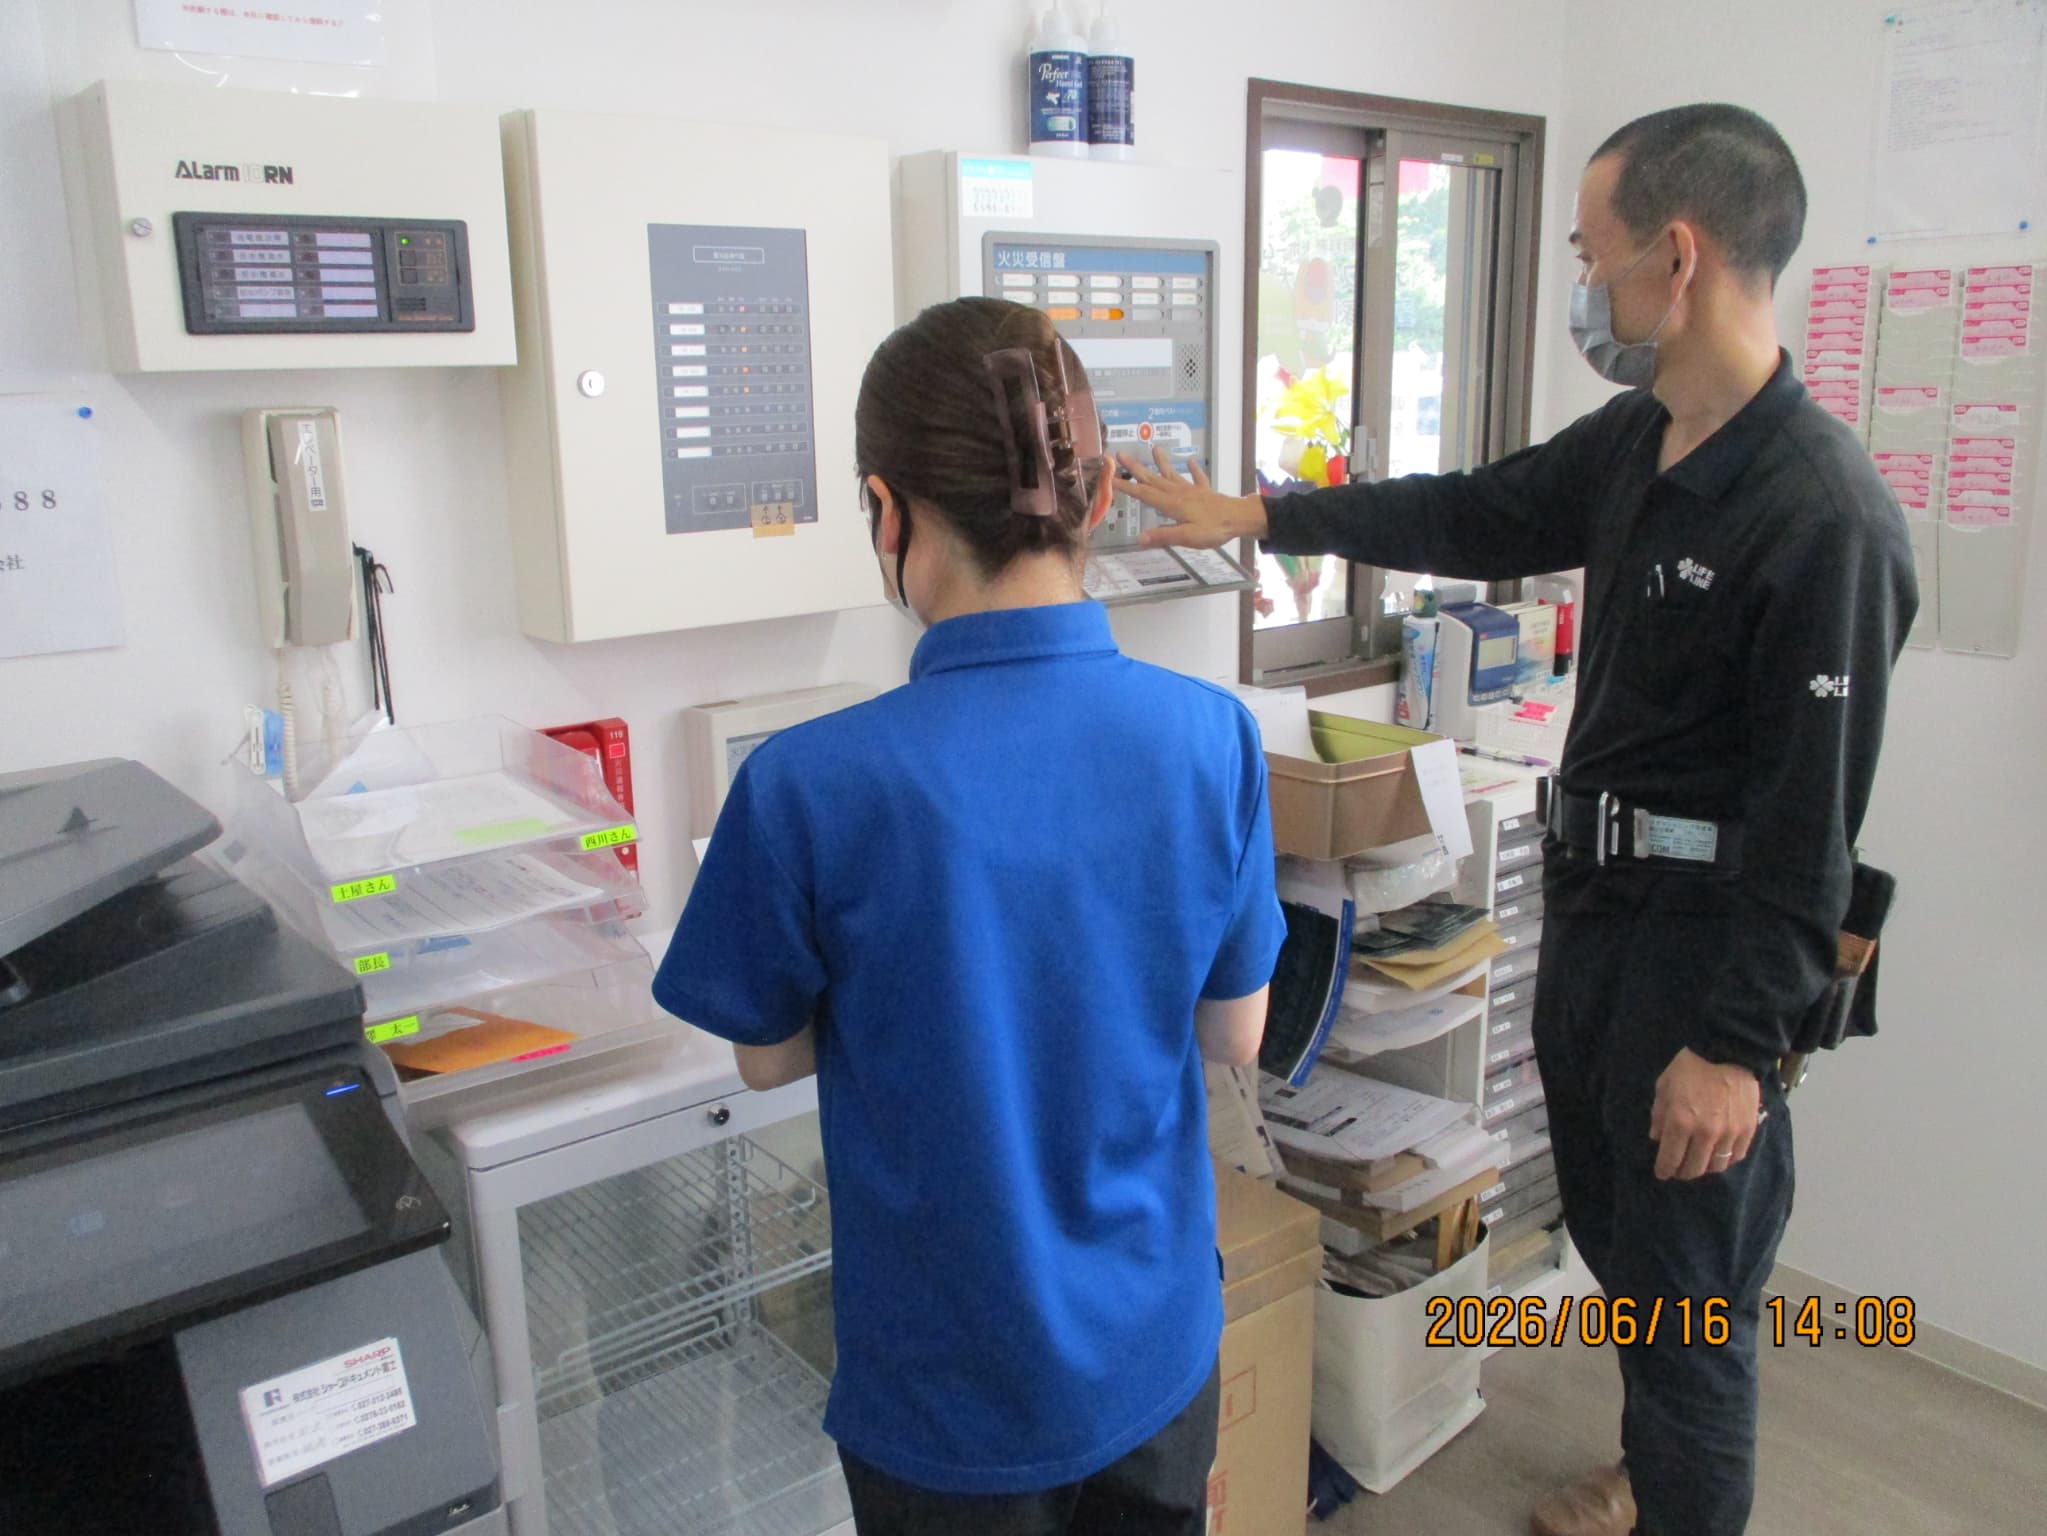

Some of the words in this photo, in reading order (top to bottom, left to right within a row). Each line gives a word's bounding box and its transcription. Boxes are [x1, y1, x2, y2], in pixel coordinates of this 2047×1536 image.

[1039, 63, 1070, 82] Perfect
[998, 251, 1066, 269] 火災受信盤
[339, 879, 391, 900] 土屋さん
[358, 956, 387, 973] 部長
[343, 1346, 392, 1368] SHARP
